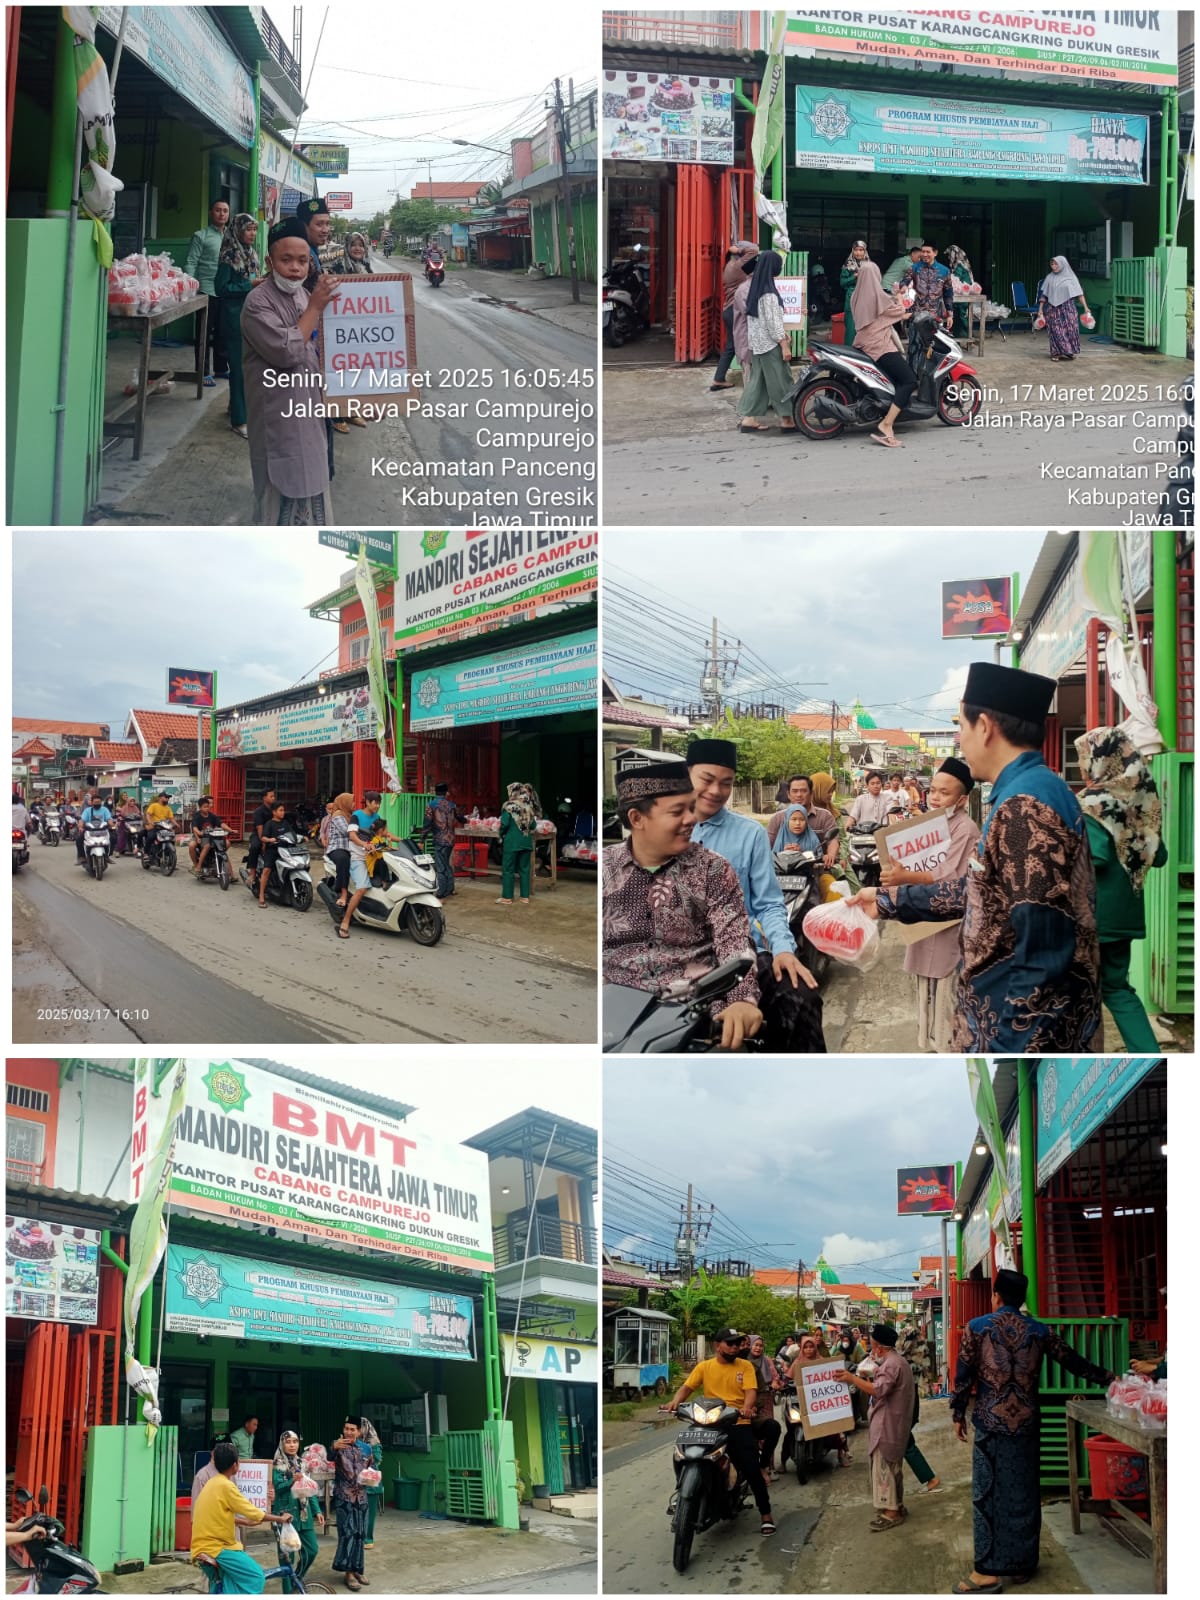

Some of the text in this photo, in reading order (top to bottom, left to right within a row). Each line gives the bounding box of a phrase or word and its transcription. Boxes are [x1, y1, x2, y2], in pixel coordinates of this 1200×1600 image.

[815, 24, 848, 36] BADAN
[850, 28, 883, 41] HUKUM
[885, 32, 897, 42] No
[868, 13, 917, 29] PUSAT
[922, 21, 1062, 48] KARANGCANGKRING
[1067, 39, 1112, 53] DUKUN
[1116, 45, 1160, 59] GRESIK
[978, 11, 1096, 37] CAMPUREJO
[856, 42, 1117, 78] Mudah, Aman, Dan Terhindar Dari Riba
[888, 109, 1039, 129] PROGRAM KHUSUS PEMBIAYAAN HAJI
[332, 296, 395, 315] TAKJIL
[335, 326, 395, 344] BAKSO
[331, 351, 405, 371] GRATIS
[368, 537, 392, 552] REGULER
[405, 549, 464, 601] MANDIRI
[452, 562, 518, 596] CABANG
[405, 602, 442, 626] KANTOR
[444, 594, 477, 615] PUSAT
[437, 619, 473, 636] Mudah,
[474, 609, 510, 625] Aman,
[512, 599, 536, 613] Dan
[539, 580, 598, 604] Terhinda
[463, 643, 597, 680] PROGRAM KHUSUS PEMBIAYAAN HAJI
[893, 830, 944, 860] TAKJIL
[132, 1086, 146, 1199] BMT
[273, 1092, 417, 1168] BMT
[175, 1105, 479, 1223] MANDIRI SEJAHTERA JAWA TIMUR
[172, 1162, 236, 1189] KANTOR
[240, 1180, 285, 1200] PUSAT
[288, 1192, 406, 1230] KARANGCANGKRING
[409, 1224, 444, 1240] DUKUN
[446, 1232, 480, 1248] GRESIK
[190, 1183, 222, 1199] BADAN
[224, 1192, 255, 1208] HUKUM
[256, 1201, 268, 1211] No
[254, 1167, 332, 1198] CABANG
[337, 1190, 431, 1223] CAMPUREJO
[229, 1206, 278, 1226] Mudah,
[282, 1218, 322, 1236] Aman,
[326, 1227, 348, 1241] Dan
[351, 1234, 402, 1252] Terhindar
[404, 1246, 425, 1257] Dari
[427, 1251, 448, 1262] Riba
[258, 1275, 298, 1288] PROGRAM
[299, 1282, 329, 1294] KHUSUS
[330, 1287, 373, 1302] PEMBIAYAAN
[810, 1394, 850, 1412] GRATIS
[811, 1383, 843, 1399] BAKSO
[237, 1470, 263, 1479] TAKJIL
